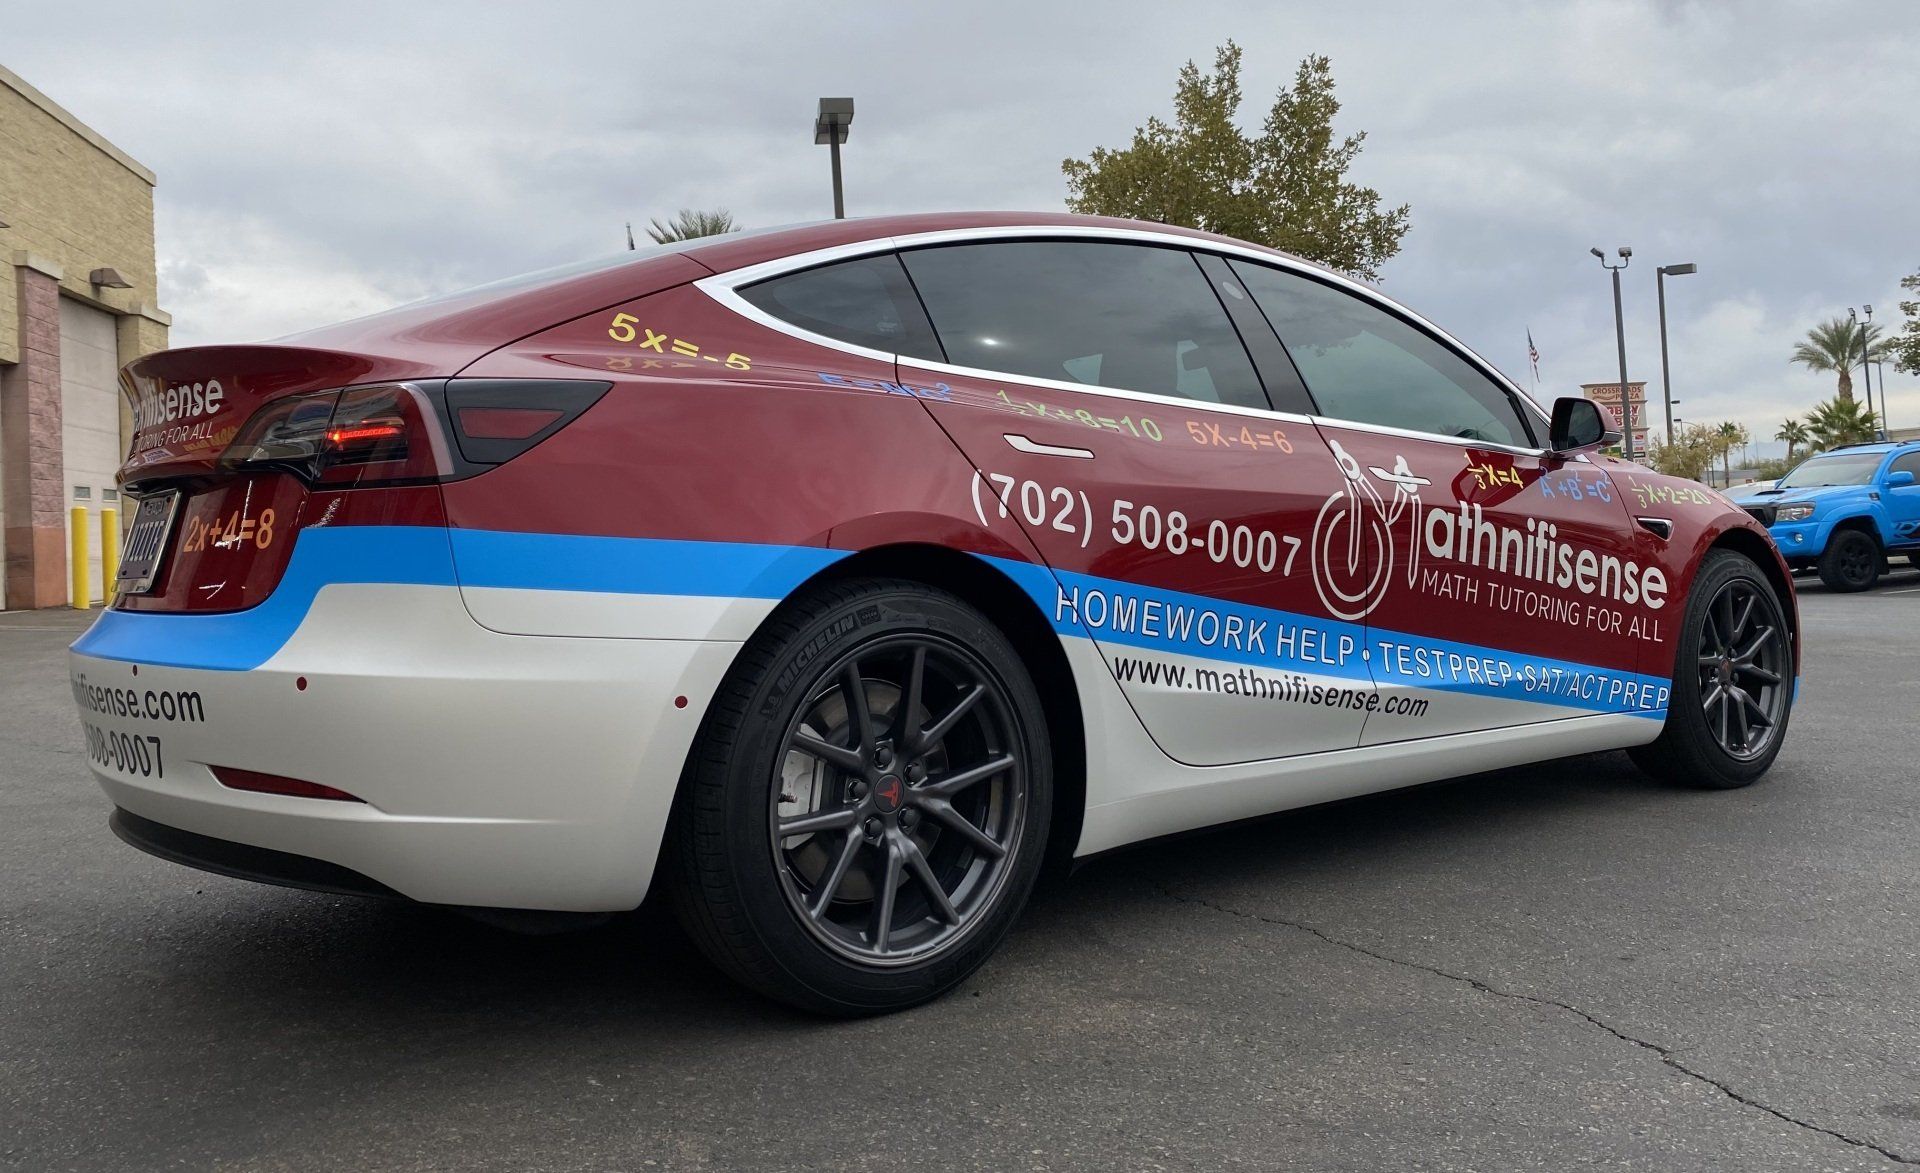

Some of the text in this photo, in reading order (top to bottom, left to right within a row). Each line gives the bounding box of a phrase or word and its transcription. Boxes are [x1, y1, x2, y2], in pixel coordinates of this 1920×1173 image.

[1592, 386, 1641, 395] CROSSRADS
[165, 425, 189, 445] FOR
[190, 421, 213, 440] ALL
[971, 468, 1301, 577] (702) 508-0007
[1055, 583, 1268, 655] HOMEWORK
[1276, 624, 1355, 667] HELP
[1421, 568, 1664, 643] MATH TUTORING FOR ALL
[777, 614, 855, 693] MICHELIN
[1114, 657, 1429, 718] www.mathnifisense.com
